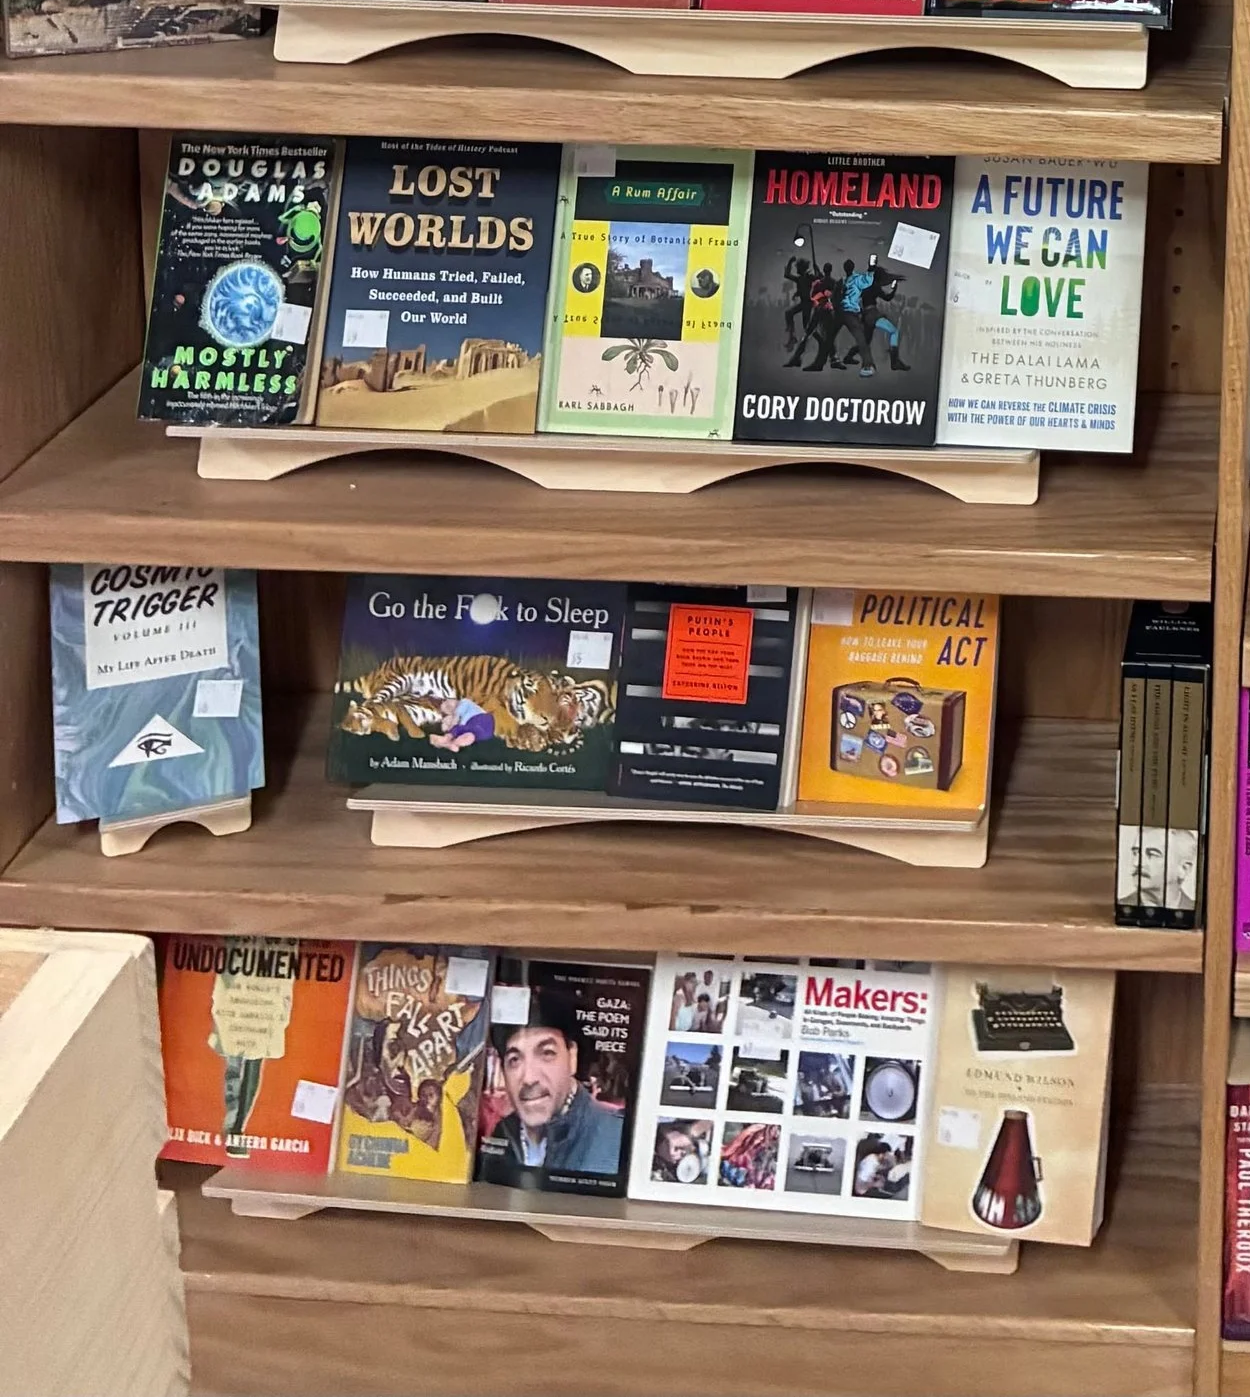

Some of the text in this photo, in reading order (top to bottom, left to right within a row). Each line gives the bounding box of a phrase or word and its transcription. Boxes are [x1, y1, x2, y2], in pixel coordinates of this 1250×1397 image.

[389, 164, 500, 199] LOST
[762, 168, 943, 211] HOMELAND
[971, 173, 1124, 221] A FUTURE
[347, 210, 535, 252] WORLDS
[986, 224, 1108, 270] WE CAN
[1000, 274, 1086, 319] LOVE
[173, 344, 289, 369] MOSTLY
[150, 368, 297, 396] HARMLESS
[742, 393, 926, 426] CORY DOCTOROW
[92, 582, 220, 628] TRIGGER
[368, 590, 405, 620] Go
[413, 598, 448, 621] the
[516, 600, 538, 622] to
[544, 596, 611, 629] Sleep
[859, 592, 987, 630] POLITICAL
[936, 634, 989, 668] ACT
[172, 942, 347, 983] UNDOCUMENTED
[596, 997, 631, 1010] GAZA:
[803, 976, 929, 1015] Makers:
[575, 1010, 630, 1024] THE POEM
[595, 1039, 626, 1053] PIECE
